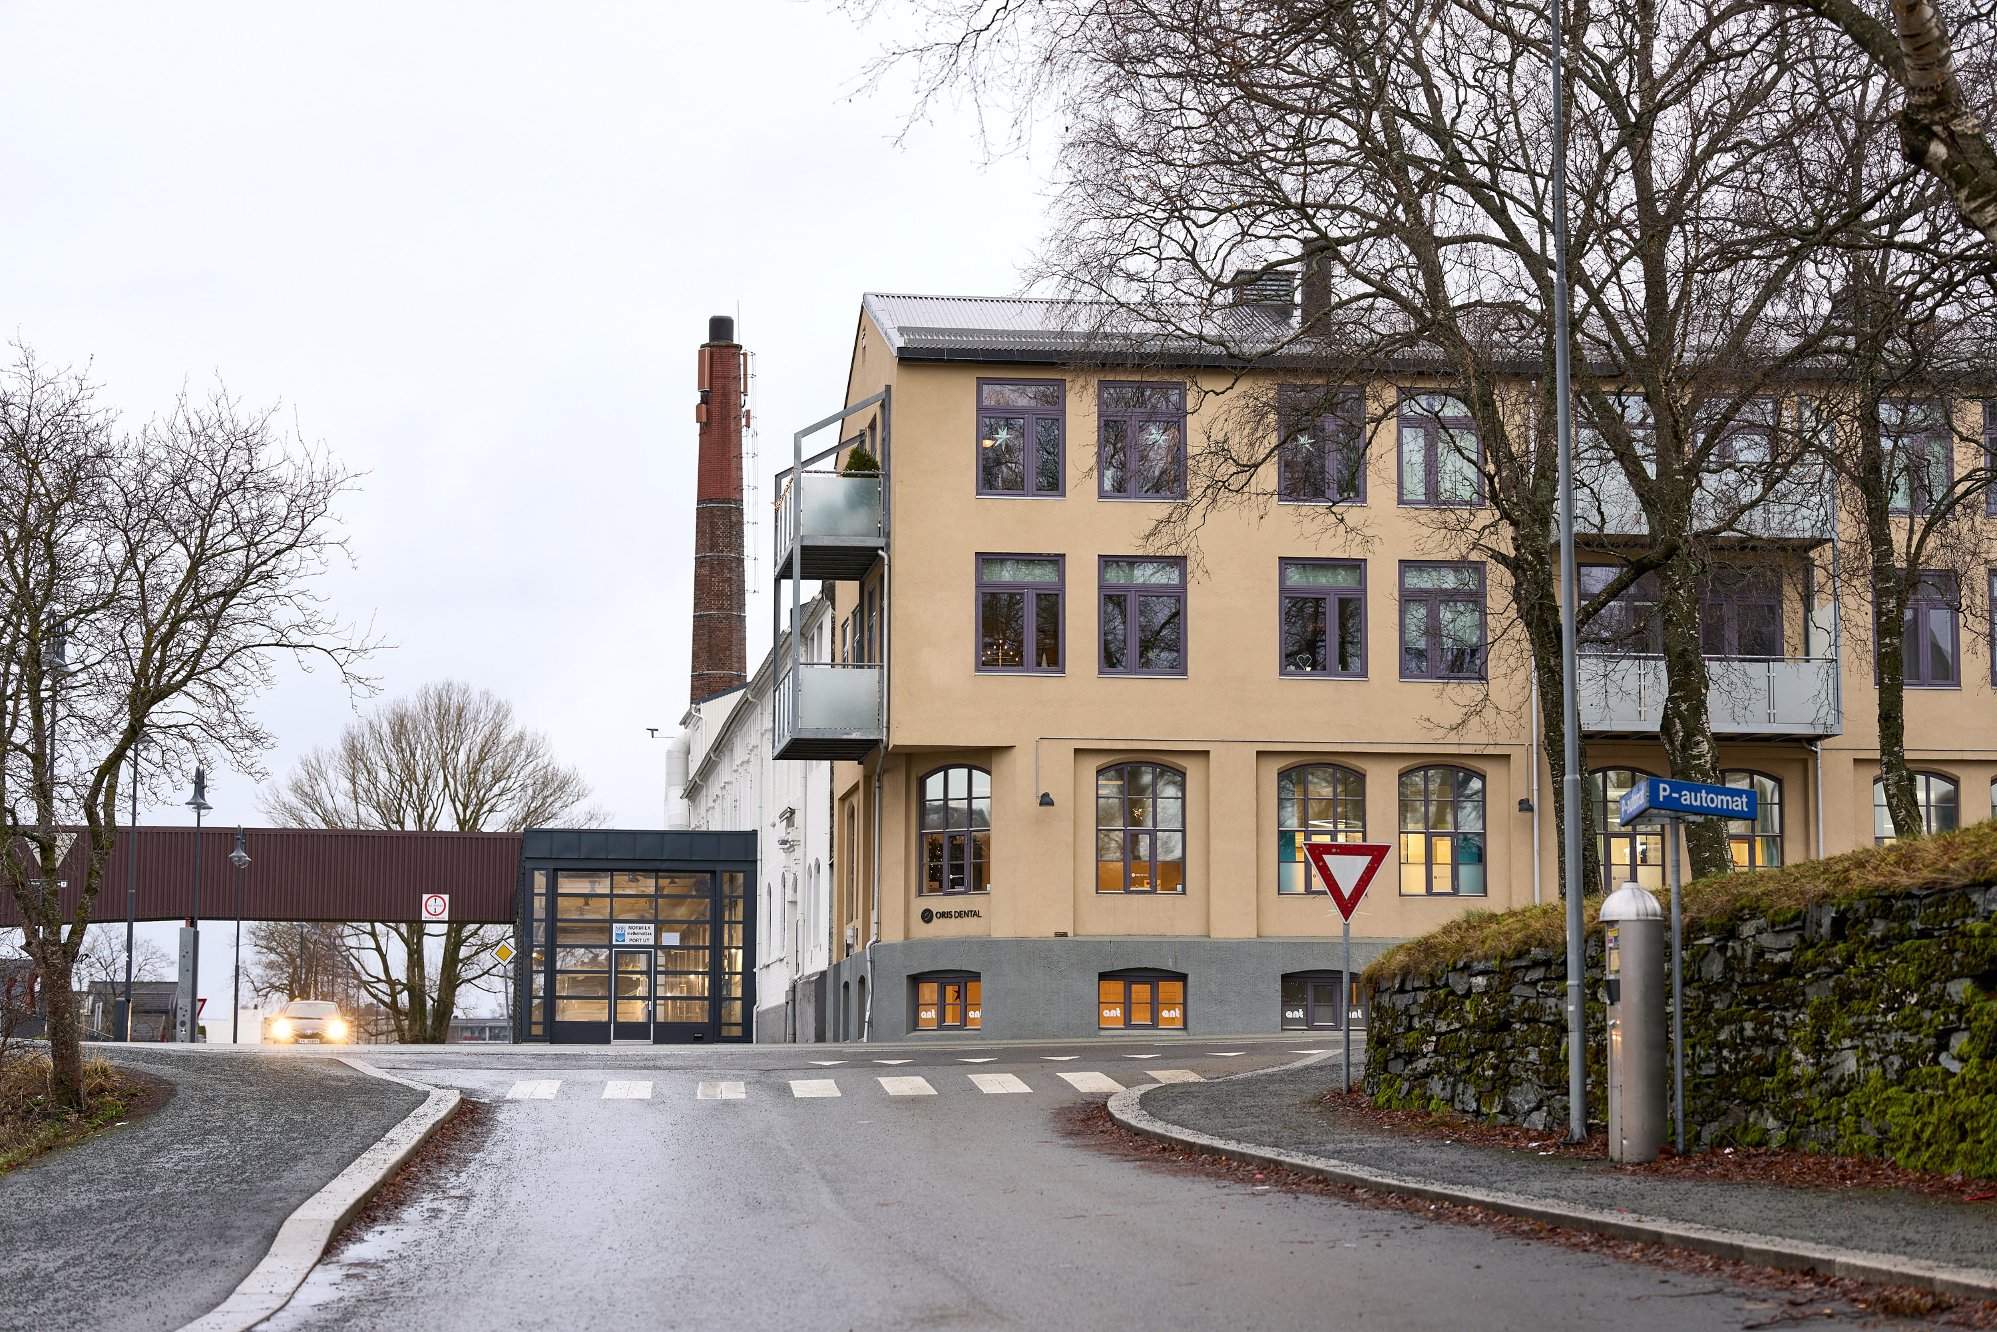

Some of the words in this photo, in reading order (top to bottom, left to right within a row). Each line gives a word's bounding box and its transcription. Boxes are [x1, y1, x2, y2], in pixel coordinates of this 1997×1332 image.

[1659, 783, 1749, 812] P-automat
[935, 910, 953, 919] ORIS
[953, 909, 982, 919] DENTAL
[920, 1008, 936, 1019] ant
[1103, 1007, 1121, 1018] ant
[1161, 1007, 1180, 1018] ant
[1285, 1008, 1304, 1019] ant
